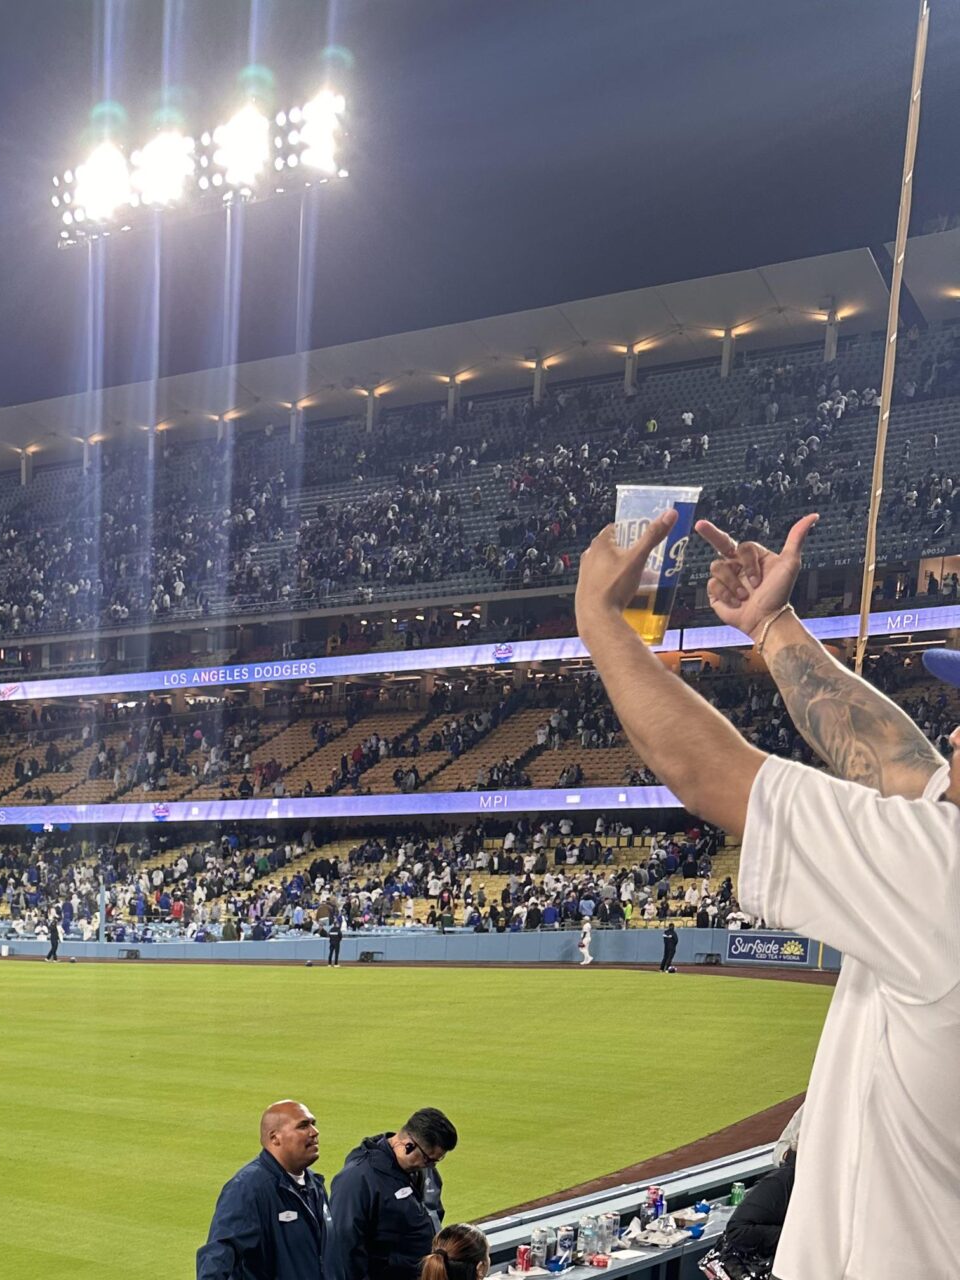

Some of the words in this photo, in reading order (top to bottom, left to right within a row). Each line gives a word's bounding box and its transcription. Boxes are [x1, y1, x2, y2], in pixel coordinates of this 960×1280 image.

[886, 614, 919, 631] MPI
[163, 672, 187, 686] LOS
[192, 667, 249, 684] ANGELES
[254, 662, 317, 679] DODGERS
[479, 794, 508, 808] MPI
[731, 937, 780, 955] Surfside
